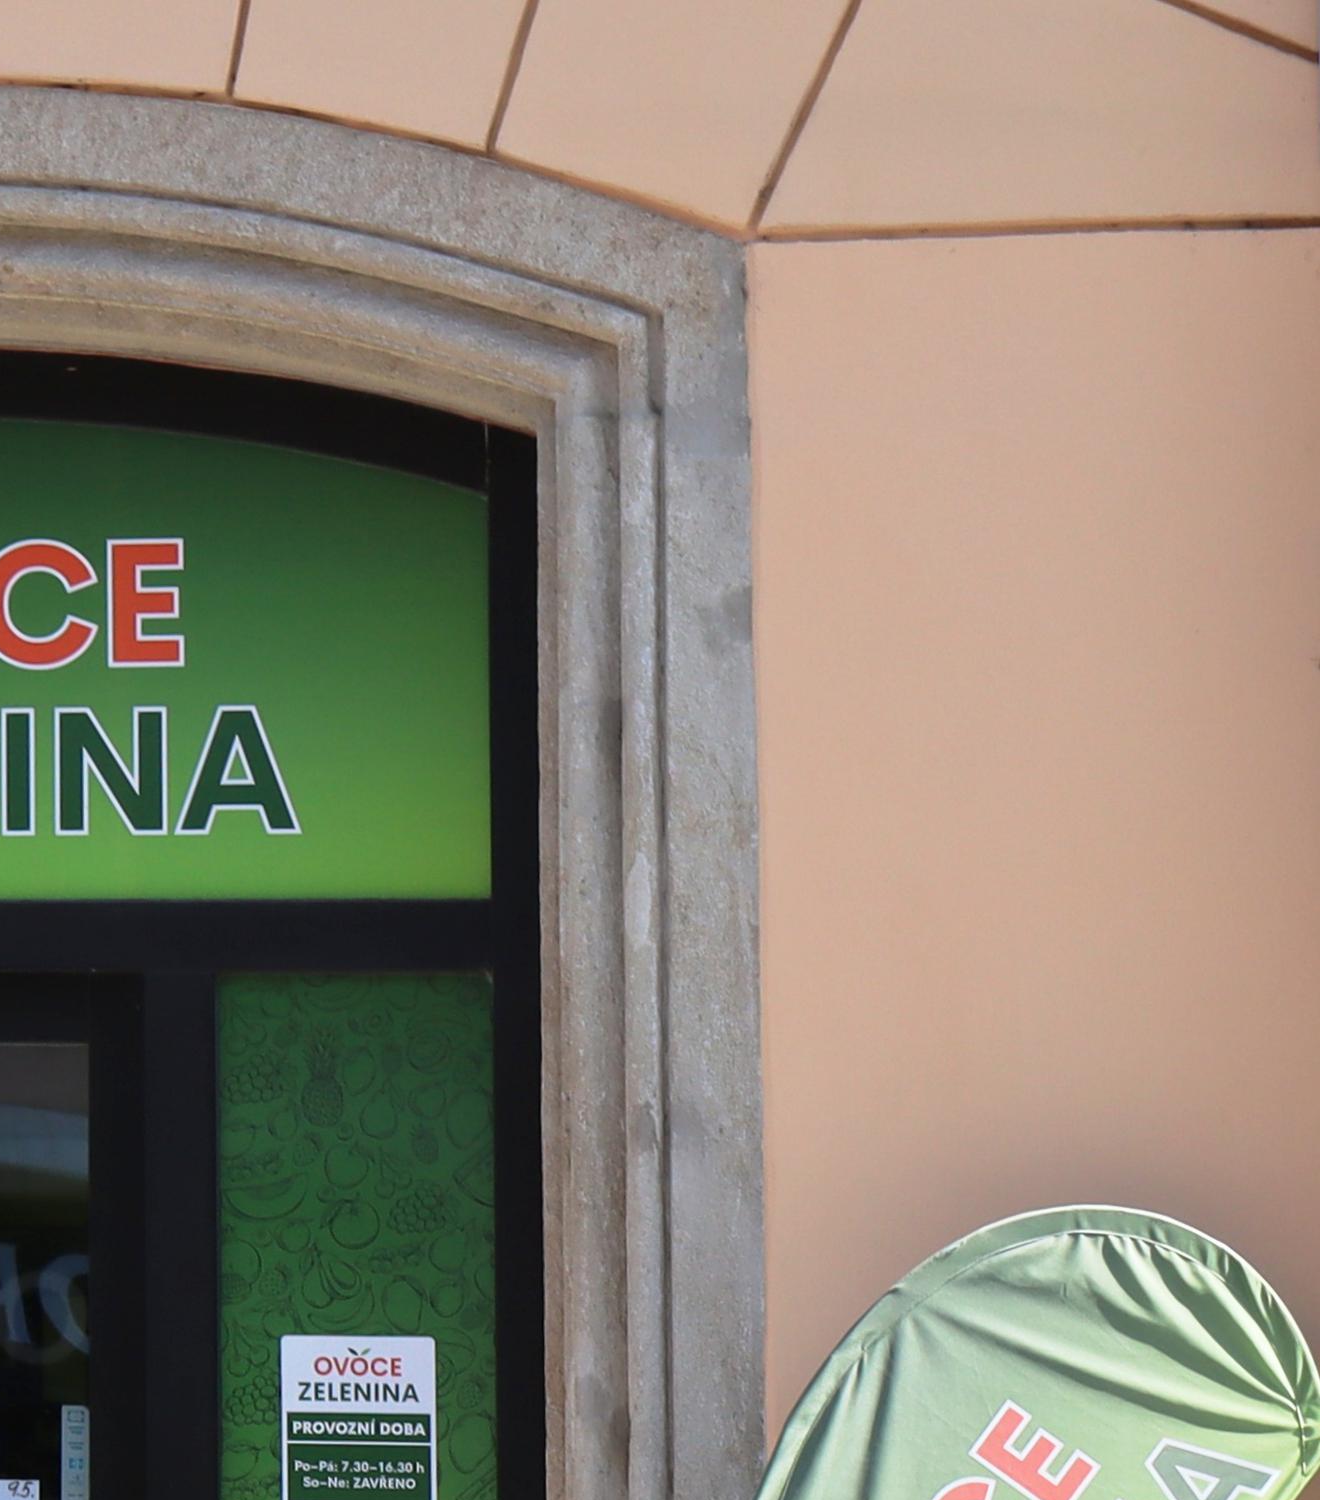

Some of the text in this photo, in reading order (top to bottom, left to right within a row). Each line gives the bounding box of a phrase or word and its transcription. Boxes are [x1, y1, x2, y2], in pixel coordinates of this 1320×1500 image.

[314, 1356, 402, 1377] OVOCE
[298, 1382, 420, 1402] ZELENINA
[292, 1418, 426, 1436] PROVOZNÍ DOBA
[416, 1462, 425, 1473] h
[353, 1475, 416, 1489] ZAVŘENO
